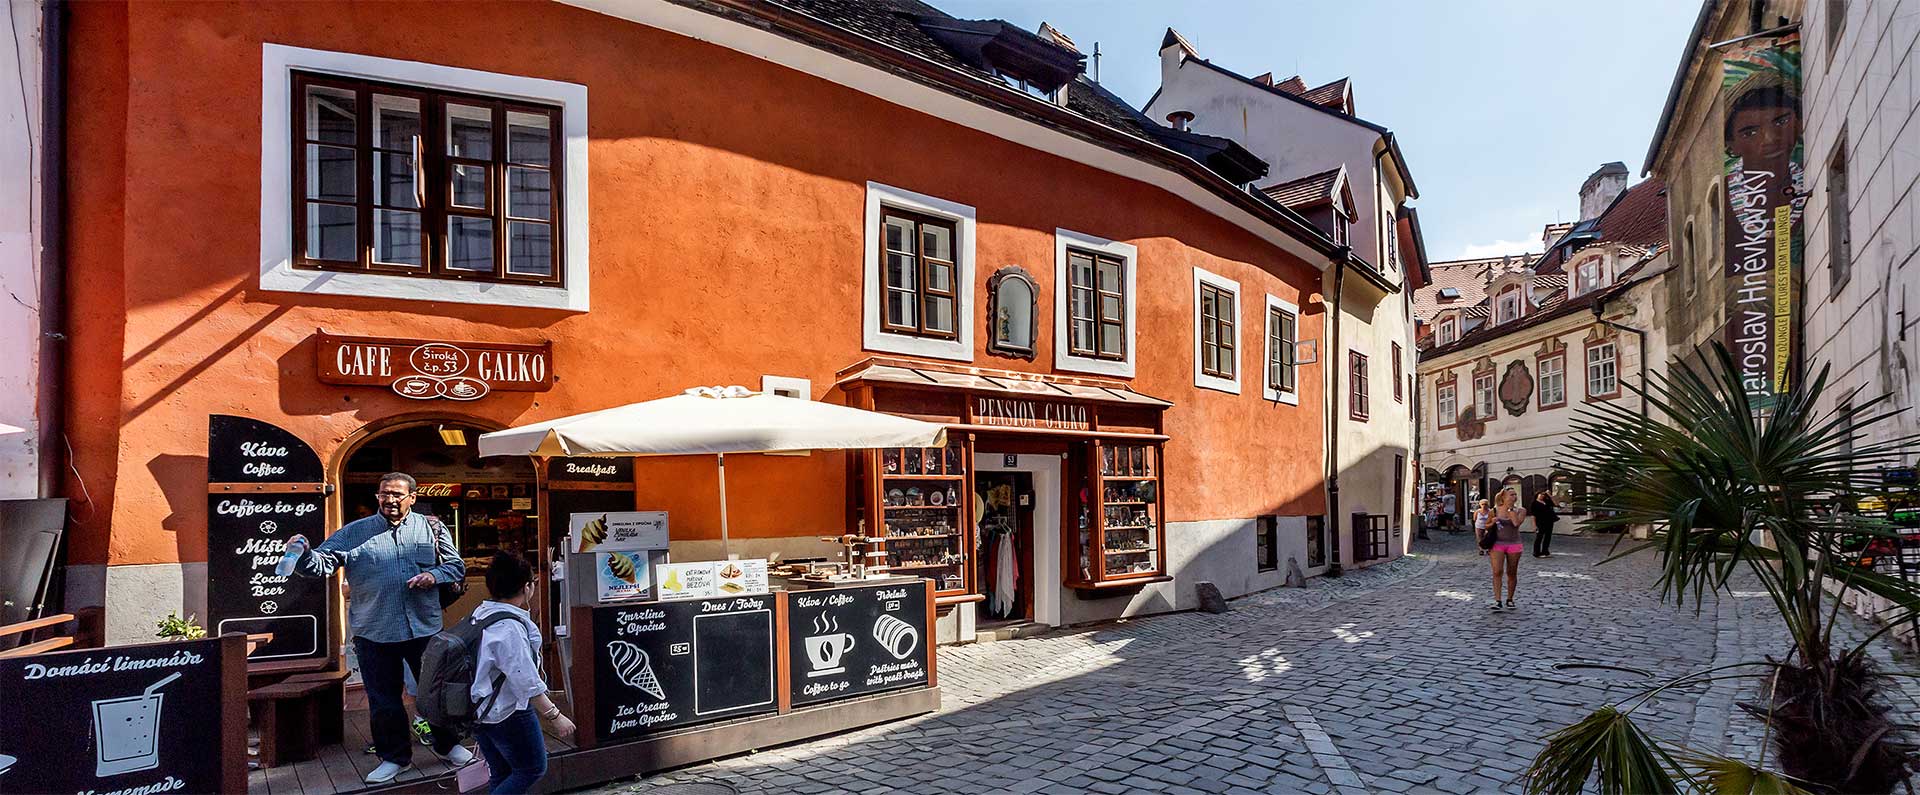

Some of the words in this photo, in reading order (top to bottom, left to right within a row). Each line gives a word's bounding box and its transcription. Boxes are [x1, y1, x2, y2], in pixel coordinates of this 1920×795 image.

[1778, 207, 1790, 233] JUNGLE
[1734, 170, 1775, 304] Hněvkovský
[1778, 233, 1789, 248] THE
[1778, 249, 1789, 273] FROM
[1778, 274, 1789, 313] PICTURES
[422, 346, 458, 361] Široká
[336, 344, 392, 377] CAFE
[478, 351, 545, 383] GALKO
[443, 361, 458, 373] 53
[979, 398, 1036, 427] PENSION
[1045, 403, 1087, 430] GALKO
[240, 441, 289, 457] Káva
[242, 462, 286, 477] Coffee
[566, 463, 617, 476] Breakfast
[217, 499, 273, 517] Coffee
[275, 501, 294, 514] to
[295, 503, 317, 516] go
[251, 585, 286, 597] Beer
[702, 602, 727, 612] Dnes
[728, 601, 735, 611] /
[736, 599, 764, 610] Today
[798, 596, 821, 607] Káva
[822, 597, 829, 606] /
[829, 594, 855, 607] Coffee
[617, 609, 666, 625] Zmrzlina
[627, 621, 667, 635] Opočna
[24, 657, 111, 680] Domácí
[113, 650, 204, 672] limonáda
[870, 664, 900, 676] Pastries
[900, 659, 919, 670] made
[867, 674, 884, 685] with
[804, 683, 829, 695] Coffee
[838, 681, 850, 692] go
[616, 706, 635, 717] Ice
[636, 701, 670, 713] Cream
[611, 720, 637, 733] from
[639, 713, 678, 728] Opočno
